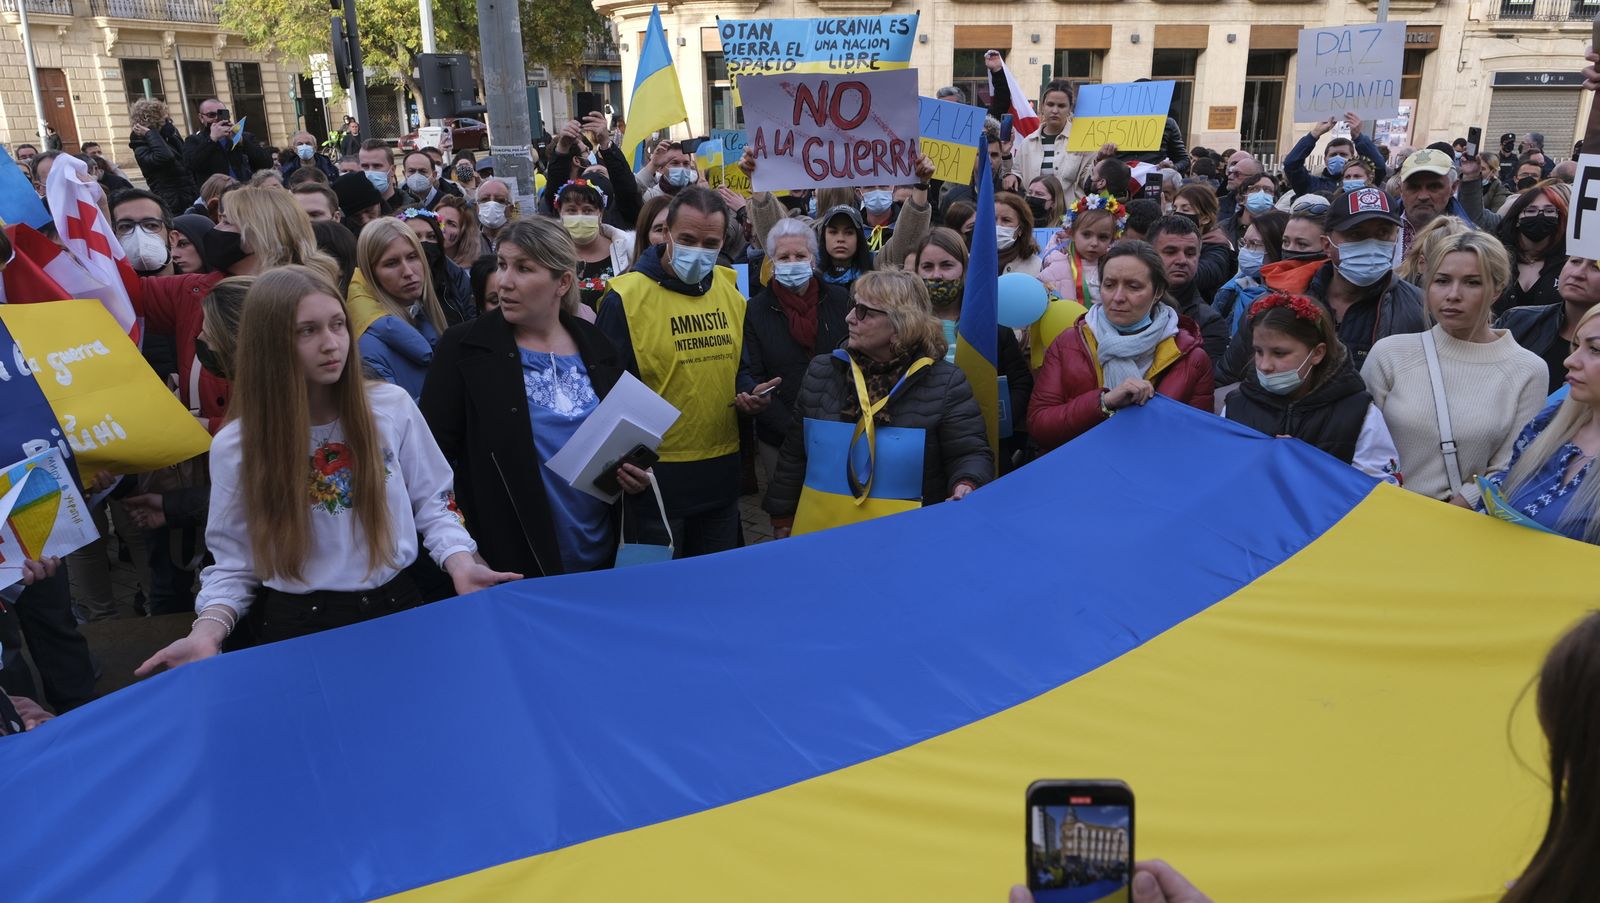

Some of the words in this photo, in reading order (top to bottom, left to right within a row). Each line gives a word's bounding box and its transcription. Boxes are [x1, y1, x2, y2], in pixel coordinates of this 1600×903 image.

[722, 22, 773, 40] OTAN
[816, 19, 882, 36] UCRANIA
[889, 18, 910, 35] ES
[723, 41, 780, 56] CIERRA
[786, 42, 804, 57] EL
[814, 39, 838, 51] UNA
[842, 37, 890, 51] NACION
[1316, 28, 1383, 65] PAZ
[828, 52, 881, 70] LIBRE
[793, 79, 872, 130] NO
[1099, 85, 1159, 115] PUTIN
[924, 104, 941, 135] A
[951, 108, 974, 143] LA
[1080, 118, 1158, 149] ASESINO
[753, 126, 768, 159] A
[774, 128, 795, 158] LA
[670, 308, 729, 336] AMNISTÍA
[674, 334, 733, 352] INTERNACIONAL
[46, 339, 111, 386] guerra
